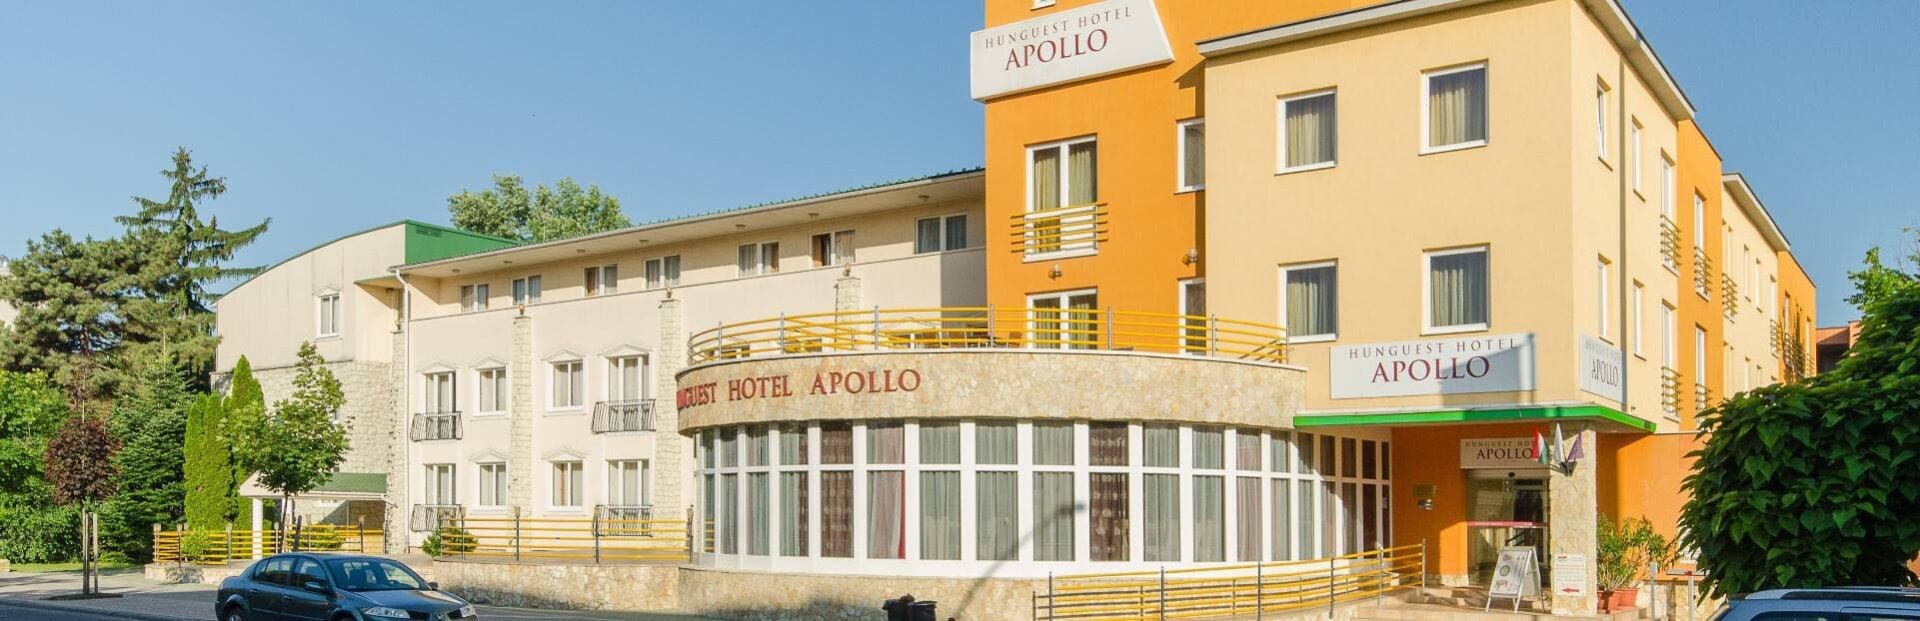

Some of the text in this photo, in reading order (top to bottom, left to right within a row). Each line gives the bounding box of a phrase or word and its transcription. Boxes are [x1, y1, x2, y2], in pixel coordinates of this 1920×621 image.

[984, 6, 1132, 49] HUNGUEST HOTEL
[1004, 28, 1108, 71] APOLLO
[1349, 337, 1518, 360] HUNGUEST HOTEL
[1372, 355, 1490, 383] APOLLO
[1592, 358, 1618, 387] APOLLO
[728, 374, 793, 401] HOTEL
[811, 368, 921, 396] APOLLO
[1465, 440, 1512, 448] HUNGUEST
[1477, 447, 1533, 460] APOLLO
